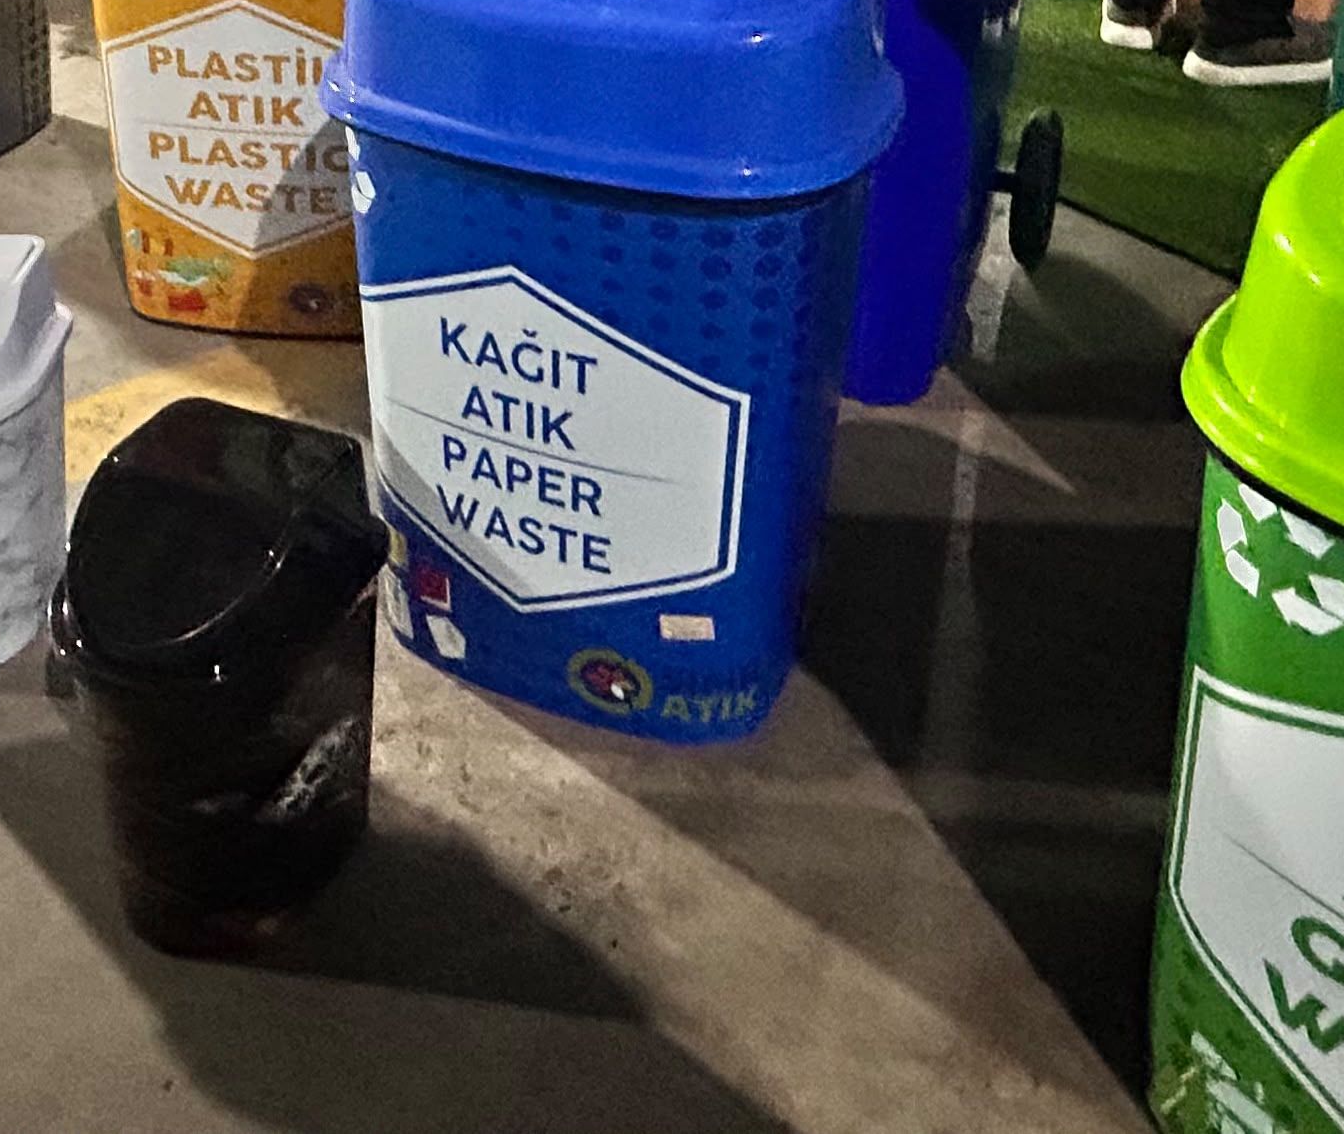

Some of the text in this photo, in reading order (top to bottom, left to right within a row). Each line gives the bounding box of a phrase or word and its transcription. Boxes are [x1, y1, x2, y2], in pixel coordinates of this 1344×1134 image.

[187, 91, 303, 127] ATIK
[149, 131, 349, 172] PLASTIC
[165, 175, 337, 214] WASTE
[440, 316, 598, 395] KAĞIT
[461, 385, 576, 450] ATIK
[442, 433, 603, 516] PAPER
[436, 484, 612, 575] WASTE
